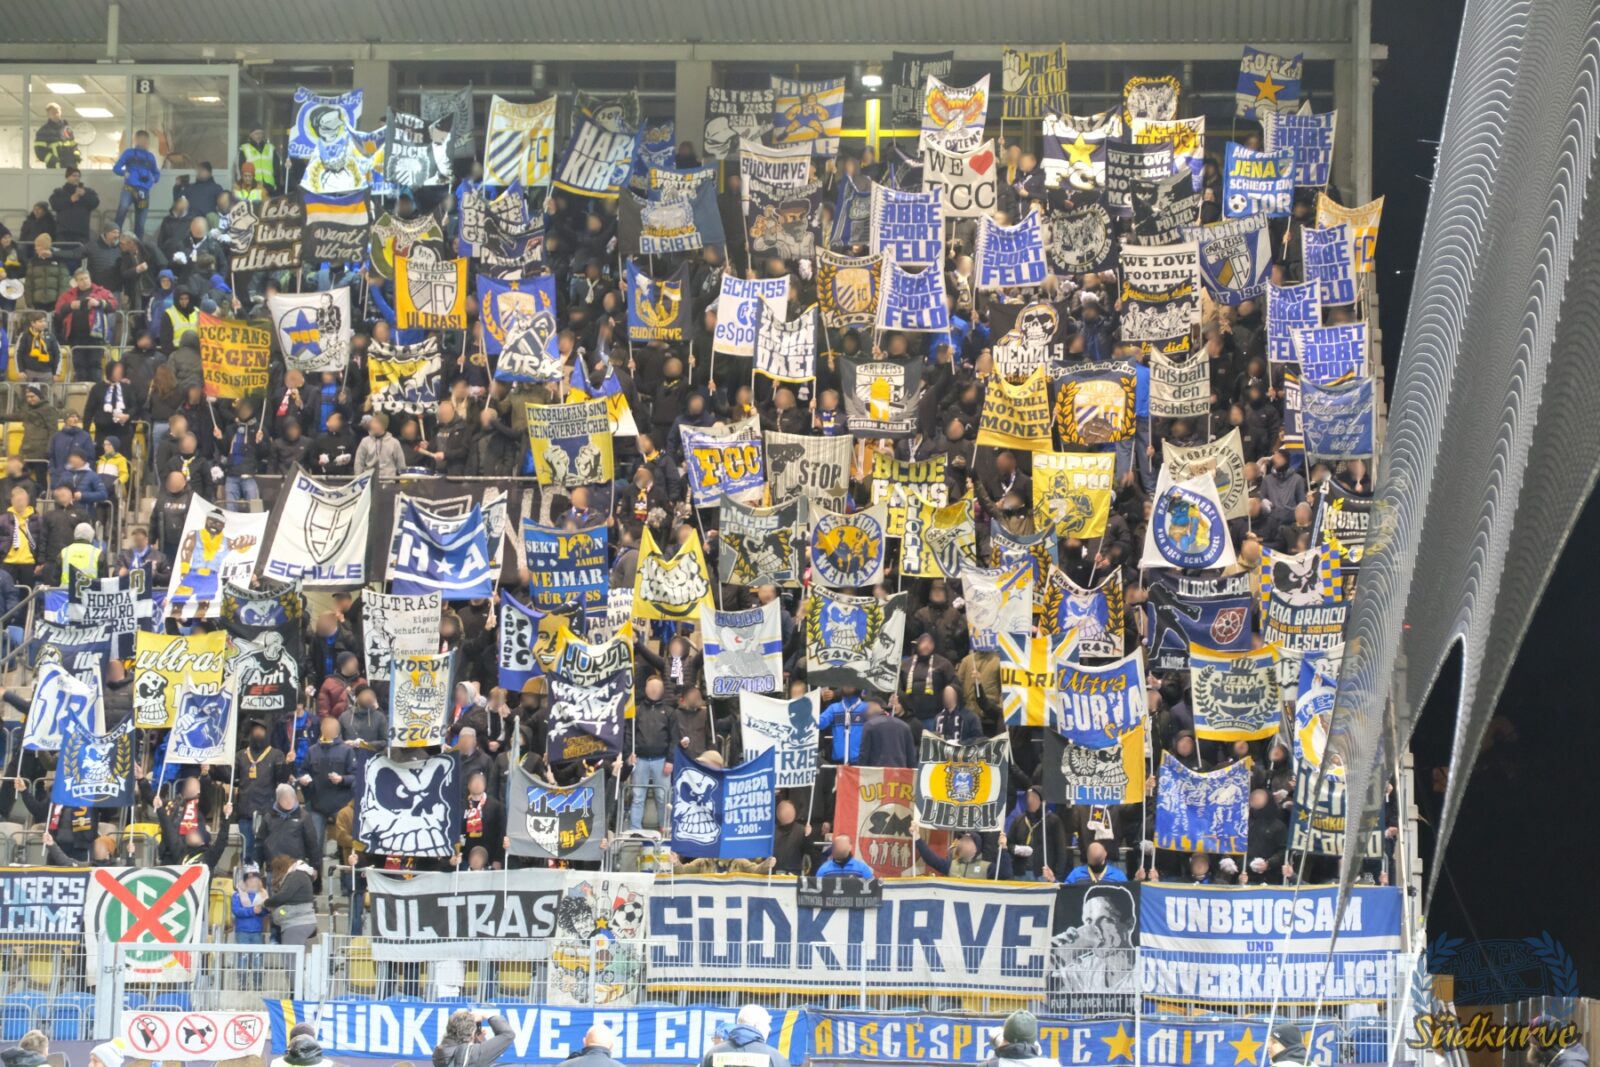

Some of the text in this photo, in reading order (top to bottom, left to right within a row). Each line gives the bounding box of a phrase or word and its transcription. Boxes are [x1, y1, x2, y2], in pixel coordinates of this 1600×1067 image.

[1240, 53, 1303, 80] FORZA
[140, 80, 150, 94] 8
[709, 88, 774, 102] ULTRAS
[710, 103, 741, 114] CARL
[394, 112, 424, 129] NUR
[1276, 111, 1333, 128] ERNST
[1275, 127, 1332, 149] ABBE
[391, 143, 428, 157] DICH
[1108, 151, 1171, 165] WE LOVE
[1232, 145, 1258, 159] AUF
[741, 157, 806, 181] SÜDKURVE
[930, 148, 964, 176] WE
[1108, 166, 1171, 179] FOOTBALL
[1229, 160, 1277, 179] JENA
[1275, 178, 1293, 191] EIN
[260, 199, 300, 219] lebe
[1247, 192, 1292, 214] TOR
[882, 204, 942, 224] ABBE
[879, 223, 942, 240] SPORT
[1182, 212, 1267, 243] TRADITION
[641, 233, 702, 254] BLEIBT!
[985, 226, 1042, 252] ABBE
[231, 245, 302, 272] ultra!
[315, 244, 363, 262] ultras
[879, 240, 943, 262] FELD
[983, 246, 1043, 267] SPORT
[1123, 254, 1197, 267] WE LOVE
[1354, 236, 1375, 264] FC
[408, 261, 431, 272] CARL
[416, 272, 447, 282] JENA
[981, 260, 1047, 286] FELD
[1124, 268, 1198, 281] FOOTBALL
[722, 278, 786, 299] SCHEISS
[892, 271, 942, 296] ABBE
[887, 291, 943, 311] SPORT
[1268, 299, 1319, 321] ABBE
[405, 311, 462, 331] ULTRAS!
[885, 305, 949, 329] FELD
[629, 327, 682, 341] SÜDKURVE
[715, 323, 755, 345] eSpo
[1302, 324, 1366, 345] ERNST
[201, 345, 269, 368] GEGEN
[993, 343, 1065, 362] NIEMALS
[1303, 341, 1365, 363] ABBE
[757, 347, 814, 379] DREI
[1303, 361, 1365, 380] SPORT
[205, 369, 269, 388] ASSISMUS
[1172, 385, 1200, 400] den
[527, 401, 608, 423] FUSSBALLFANS SIND
[983, 401, 1049, 421] NOT THE
[1151, 399, 1209, 415] aschisten
[553, 418, 610, 439] VERBRECHER
[979, 414, 1052, 438] MONEY
[692, 444, 762, 488] FCC
[798, 459, 842, 490] STOP
[873, 451, 947, 483] BLUE
[297, 476, 326, 497] DIE
[872, 478, 948, 508] FANS
[720, 508, 780, 528] ultras
[269, 559, 363, 580] SCHULE
[574, 555, 606, 567] JAHRE
[530, 567, 604, 588] WEIMAR
[1178, 578, 1218, 597] ULTRAS
[87, 593, 132, 608] HORDA
[367, 593, 440, 612] ULTRAS
[538, 589, 563, 605] FÜR
[83, 604, 134, 620] AZZURO
[1294, 605, 1346, 626] BRANCO
[136, 637, 224, 672] ultras
[391, 656, 449, 672] HORDA
[562, 641, 632, 673] HORDA
[818, 649, 867, 666] GANG
[248, 665, 285, 687] Anti
[1057, 668, 1127, 695] Ultra
[1223, 674, 1258, 686] JENA
[1223, 685, 1252, 695] CITY
[241, 696, 284, 709] ACTION
[1058, 685, 1146, 733] CURVA
[729, 774, 769, 796] HORDA
[859, 781, 914, 802] ULTR
[724, 790, 772, 811] AZZURO
[724, 806, 772, 825] ULTRAS
[920, 796, 999, 829] LIBERI!
[375, 894, 560, 938] ULTRAS
[1165, 896, 1363, 934] UNBEUGSAM
[650, 895, 1049, 977] SÜDKURVE
[1246, 941, 1274, 952] UND
[1140, 956, 1398, 998] UNVERKÄUFLICH
[302, 1003, 571, 1059] SÜDKVE
[814, 1018, 1226, 1065] AUSGESPETE MIT
